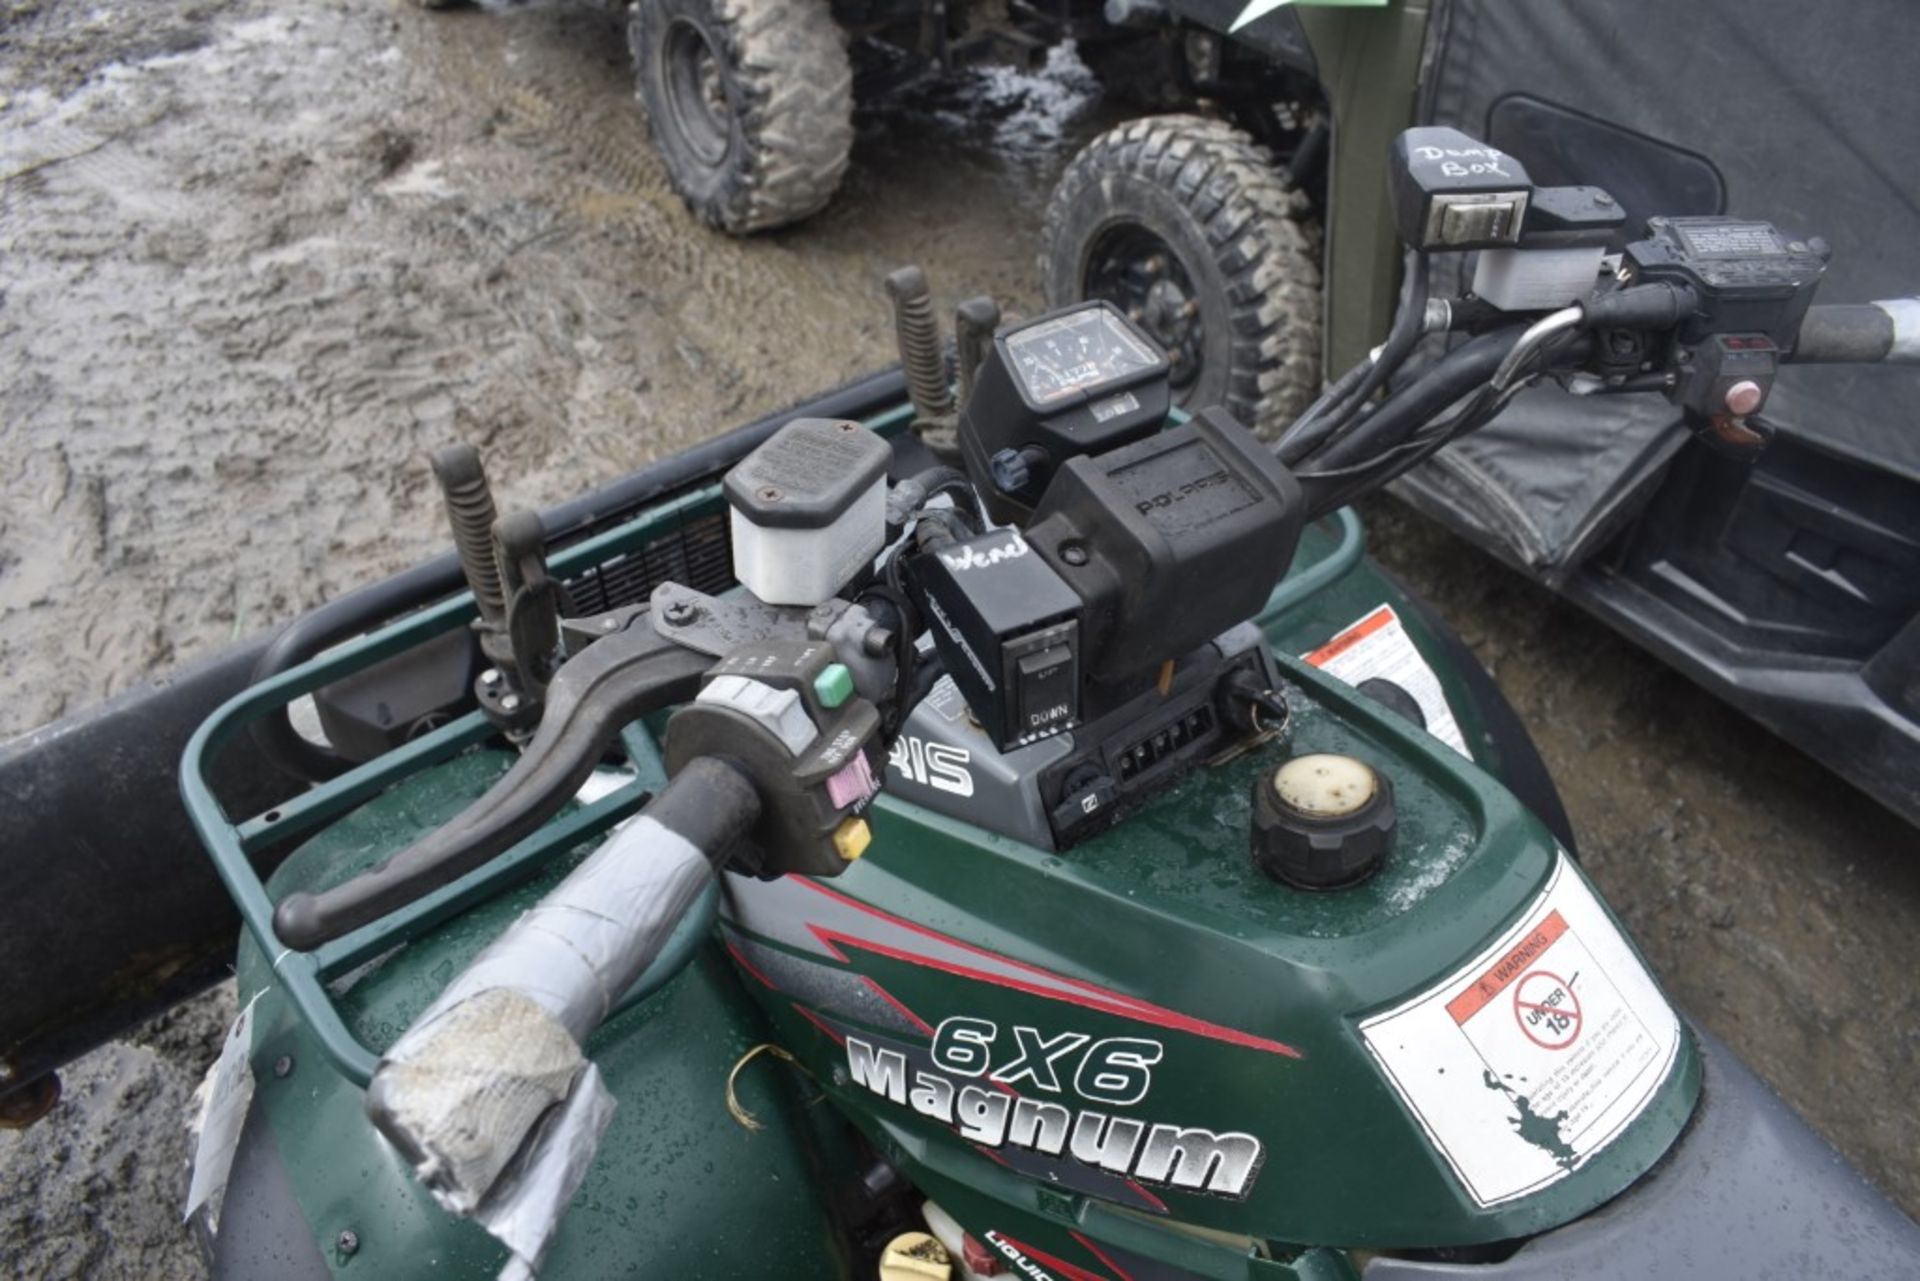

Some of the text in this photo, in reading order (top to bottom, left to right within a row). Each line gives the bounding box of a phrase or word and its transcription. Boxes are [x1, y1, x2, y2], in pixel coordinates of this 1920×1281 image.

[1134, 469, 1229, 516] POLARIS
[1030, 704, 1068, 726] DOWN
[1493, 932, 1548, 982] WARNING
[1525, 986, 1567, 1026] UNDER
[931, 1016, 1163, 1105] 6X6
[846, 1036, 1264, 1200] Magnum
